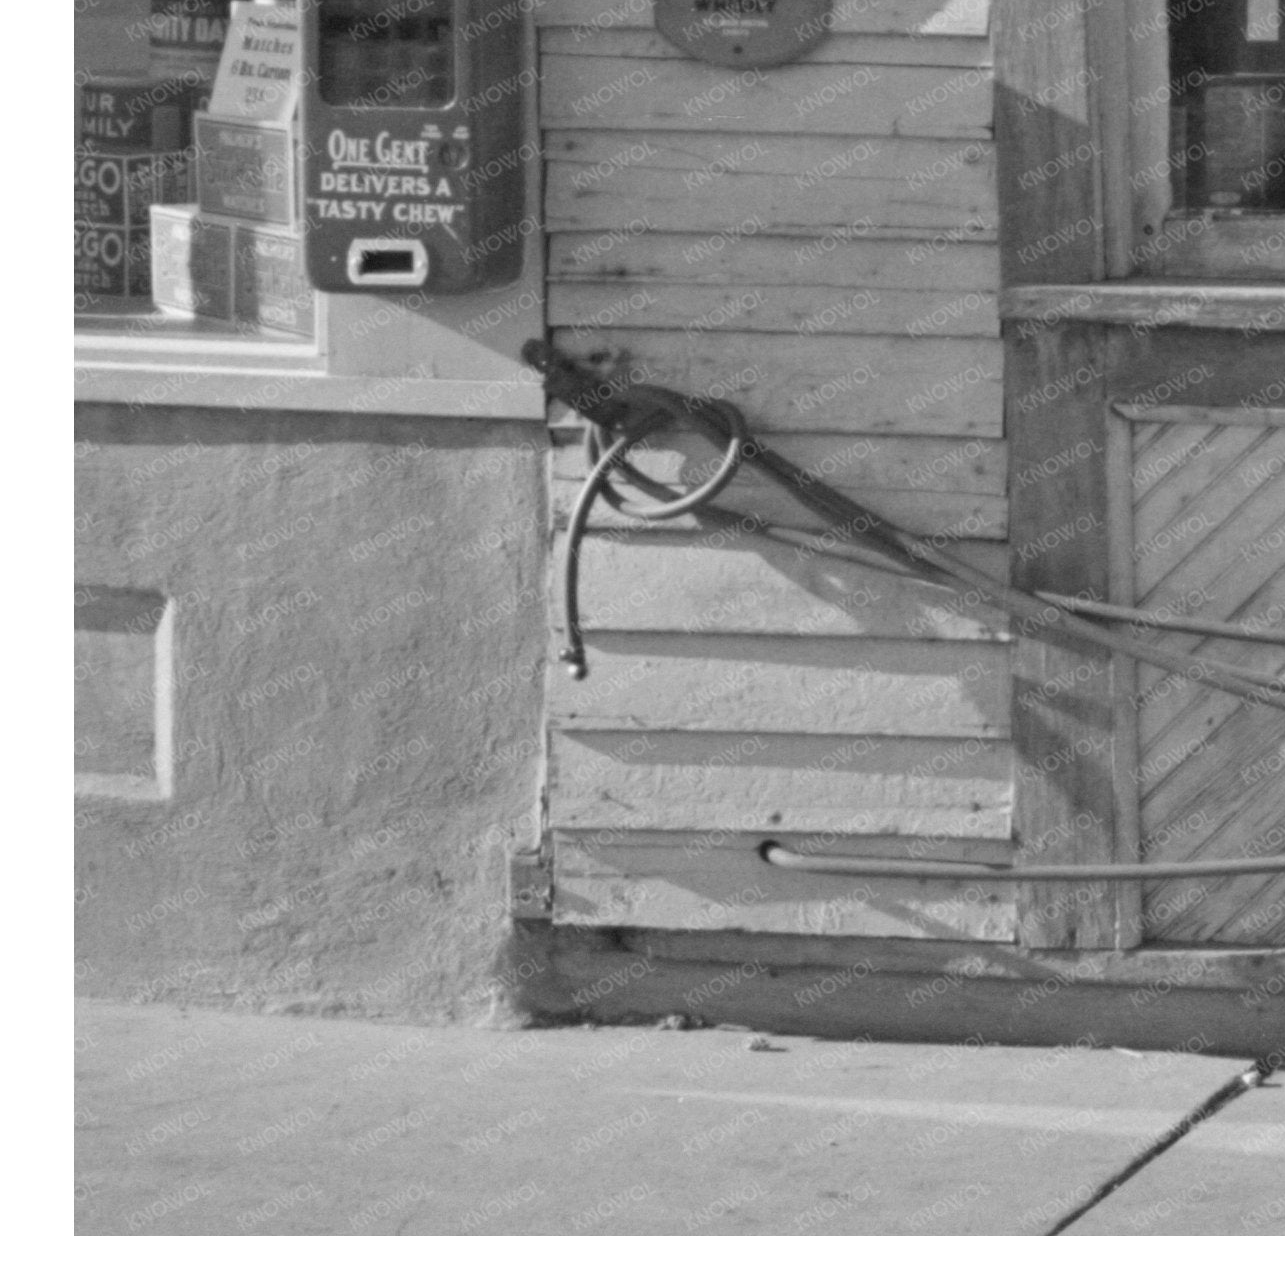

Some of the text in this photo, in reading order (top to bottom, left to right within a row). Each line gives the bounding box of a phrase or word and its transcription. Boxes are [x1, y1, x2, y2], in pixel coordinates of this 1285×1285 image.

[242, 34, 295, 55] Matches
[327, 128, 371, 164] ONE
[76, 160, 122, 195] GO
[320, 172, 452, 198] DELIVERS A
